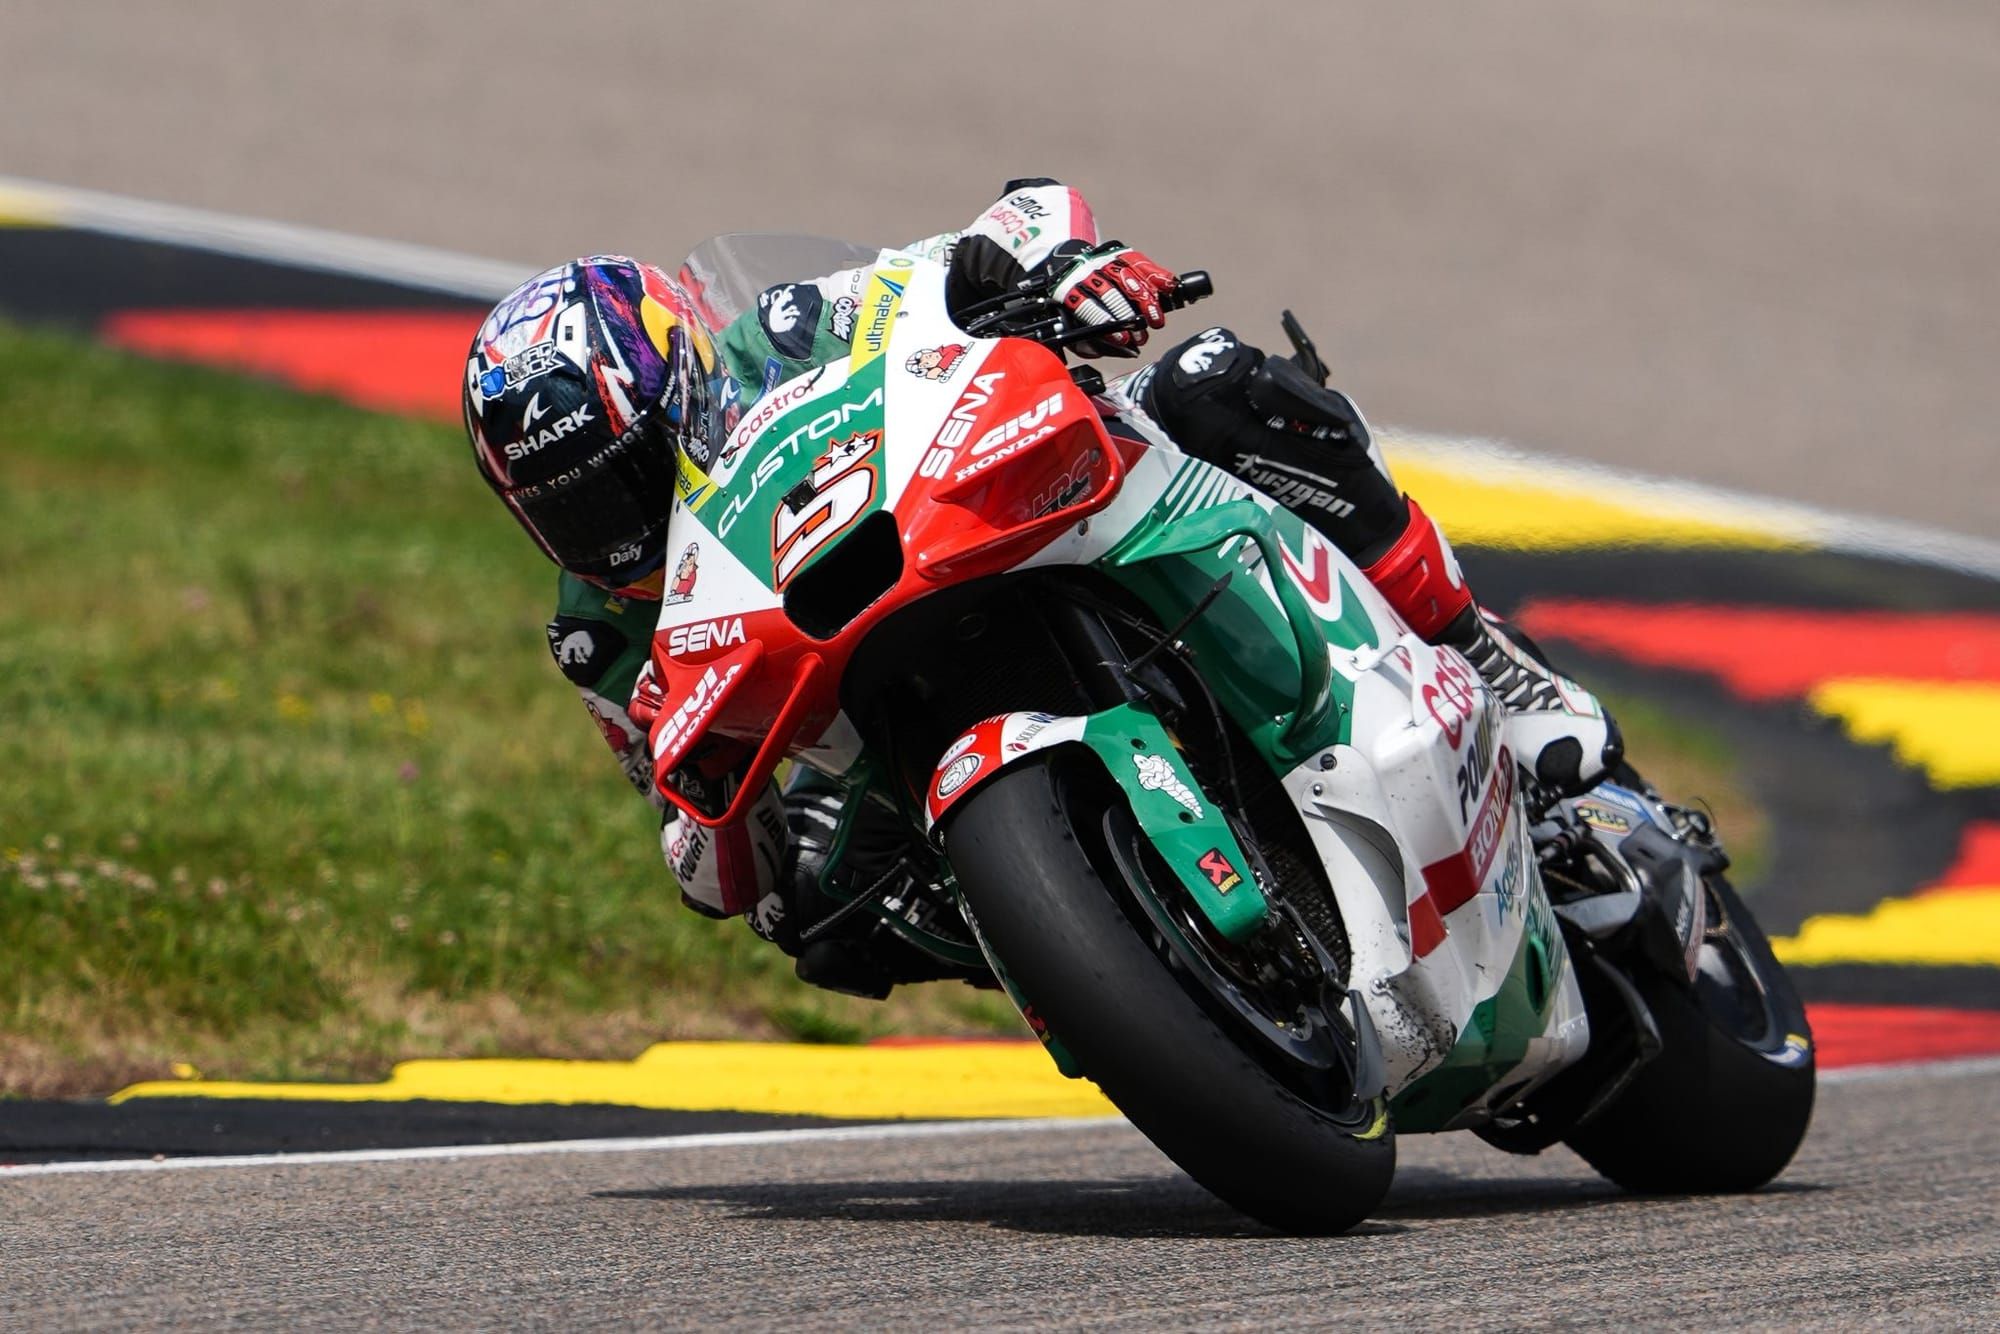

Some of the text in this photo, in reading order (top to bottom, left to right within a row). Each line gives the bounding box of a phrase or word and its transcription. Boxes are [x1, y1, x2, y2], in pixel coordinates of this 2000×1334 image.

[867, 293, 894, 352] ultimate
[504, 403, 596, 461] SHARK
[547, 467, 581, 490] YOU
[588, 423, 647, 469] WINGS
[919, 372, 1006, 480] SENA
[955, 425, 1057, 482] HONDA
[970, 392, 1064, 456] GIVI
[717, 387, 884, 539] CUSTOM
[1235, 453, 1356, 519] Furygan
[771, 428, 884, 594] 5
[669, 617, 746, 657] SENA
[654, 666, 719, 760] GIVI
[670, 663, 742, 757] HONDA
